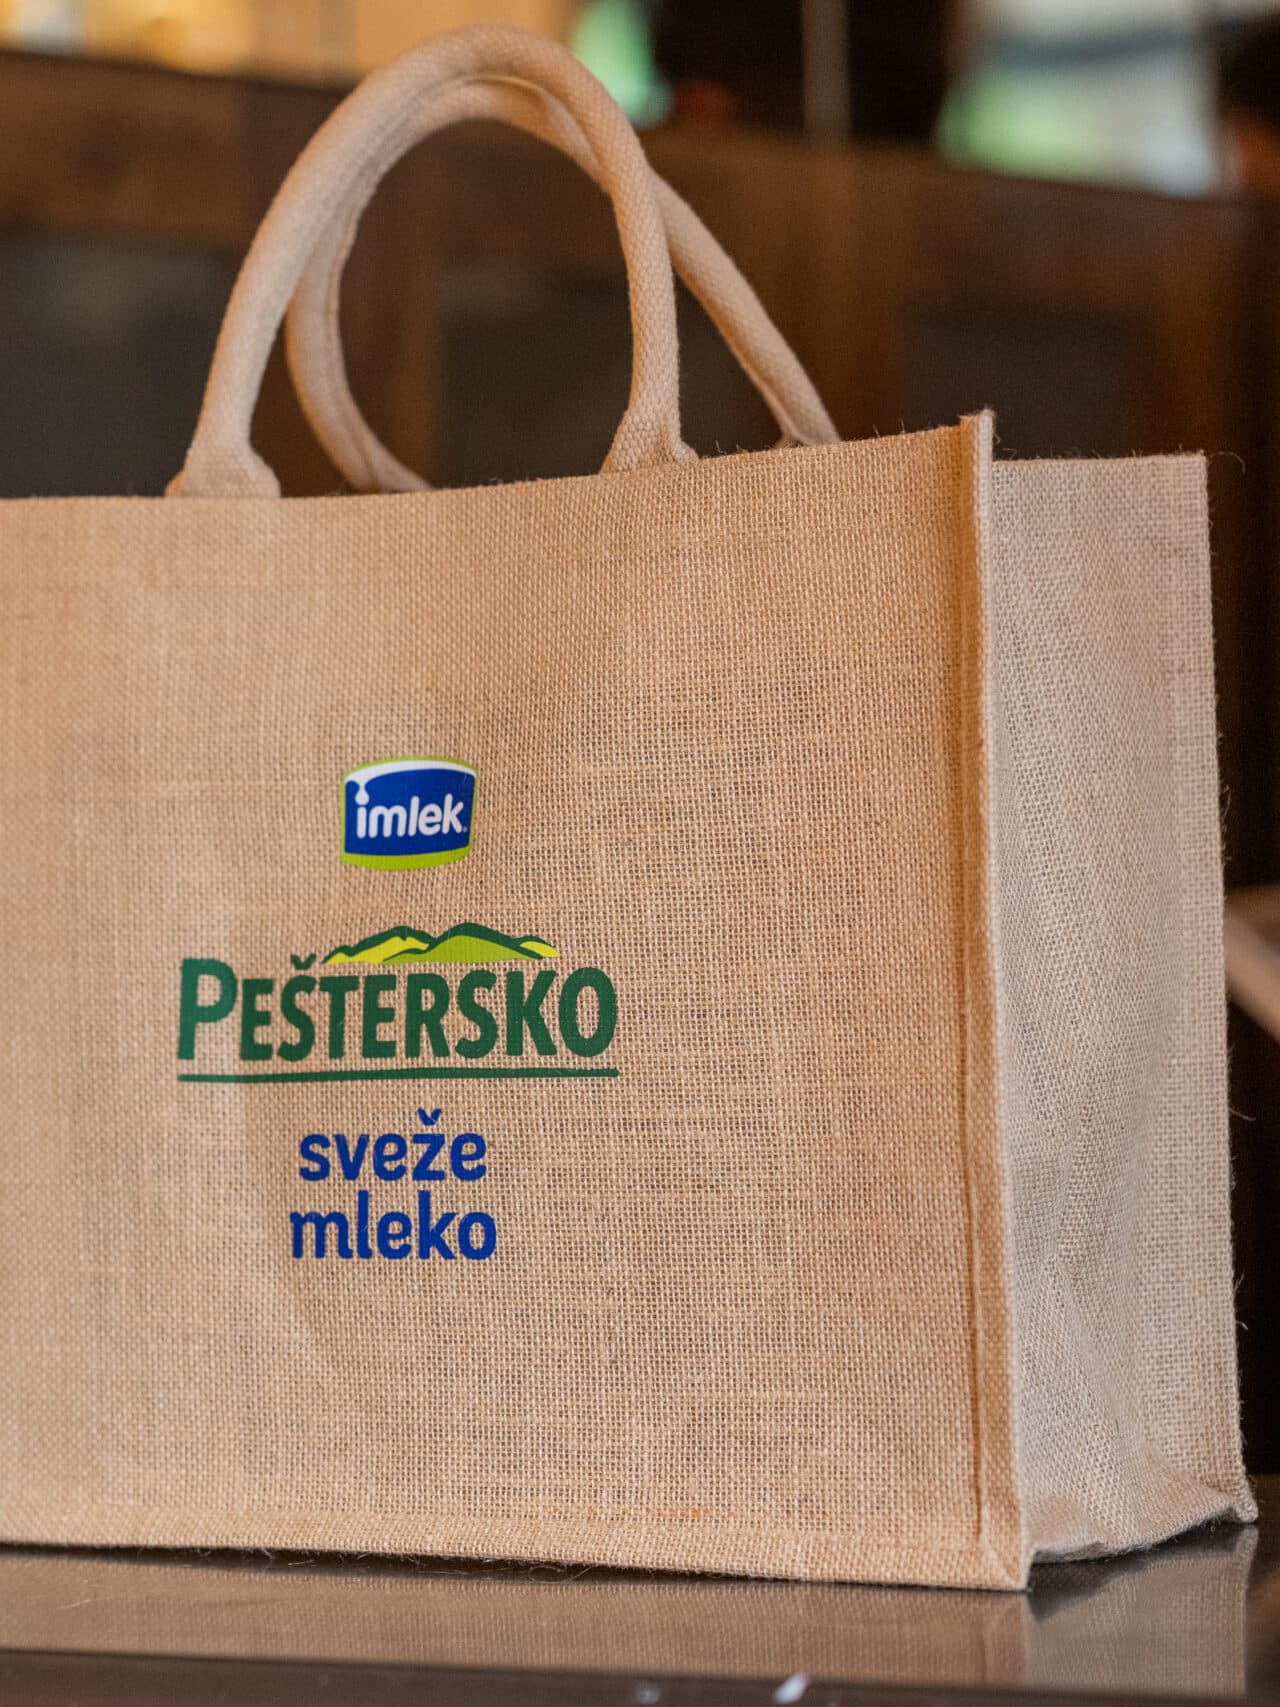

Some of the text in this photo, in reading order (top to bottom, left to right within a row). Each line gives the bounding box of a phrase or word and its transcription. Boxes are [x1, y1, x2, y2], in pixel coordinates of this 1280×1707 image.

[356, 789, 465, 840] imlek
[177, 953, 619, 1062] PEŠTERSKO
[299, 1107, 488, 1183] sveže
[290, 1189, 498, 1261] mleko
